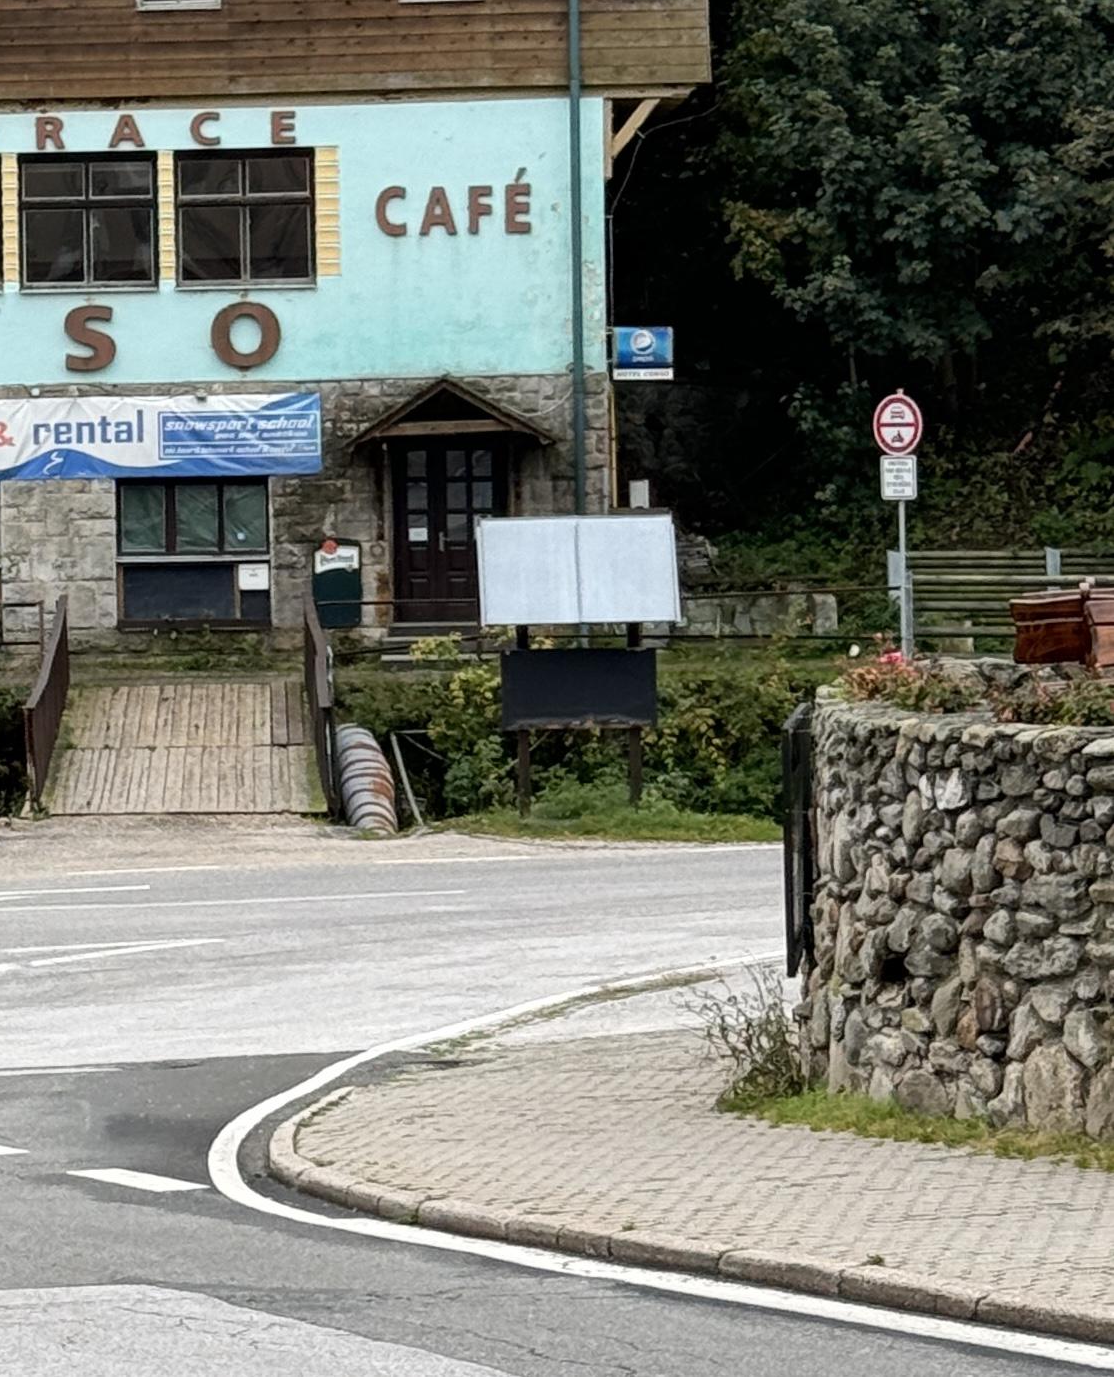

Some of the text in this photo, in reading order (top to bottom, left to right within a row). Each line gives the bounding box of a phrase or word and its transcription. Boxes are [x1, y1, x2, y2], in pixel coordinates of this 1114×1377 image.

[375, 168, 533, 237] CAFÉ
[33, 409, 143, 445] rental
[164, 414, 315, 433] snowsport school
